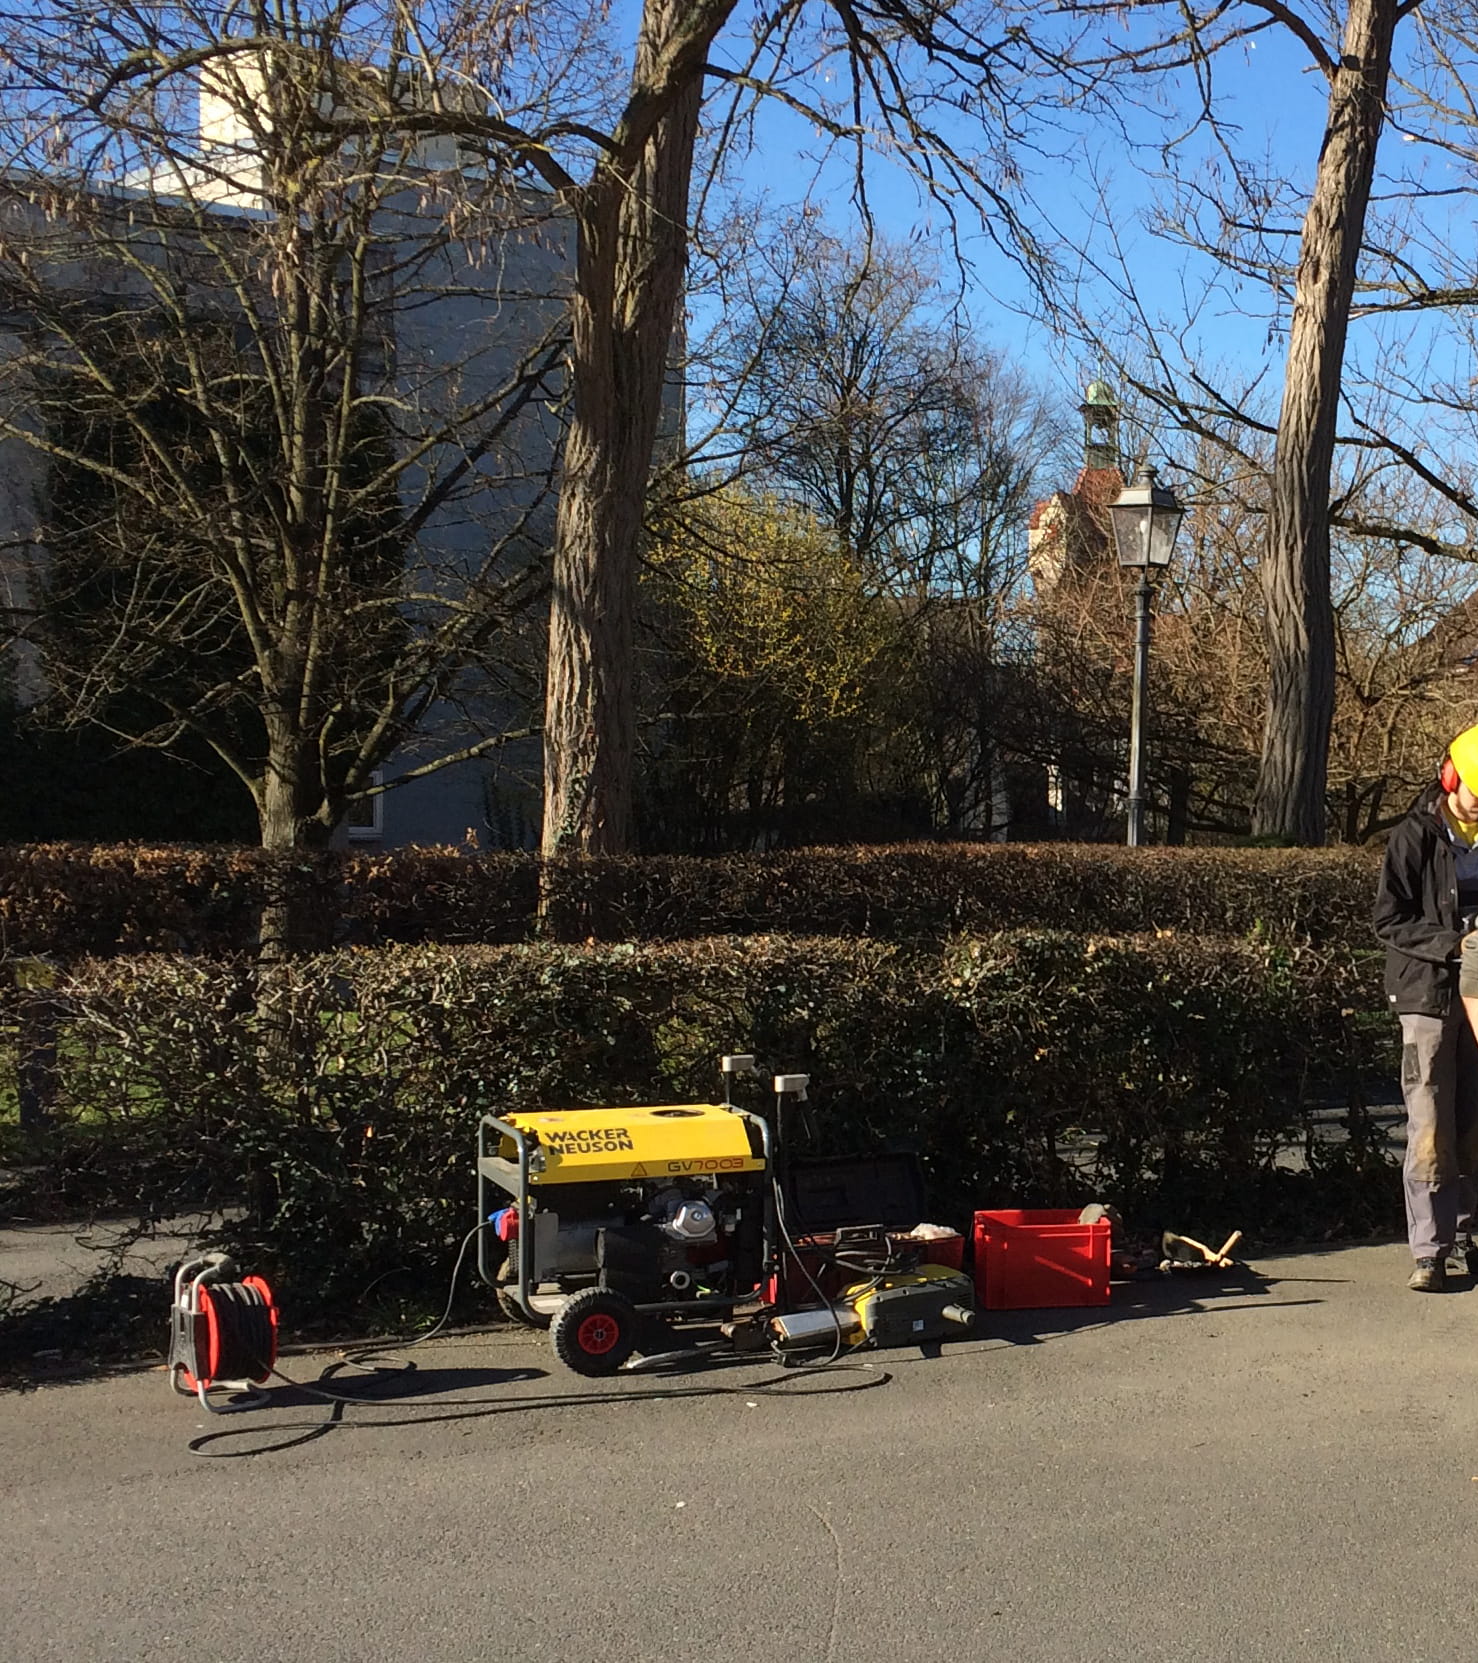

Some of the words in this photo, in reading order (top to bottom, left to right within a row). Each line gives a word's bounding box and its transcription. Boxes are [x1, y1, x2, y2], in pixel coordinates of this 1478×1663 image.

[545, 1127, 630, 1143] WACKER
[548, 1139, 634, 1156] NEUSON
[667, 1157, 744, 1173] GV7003
